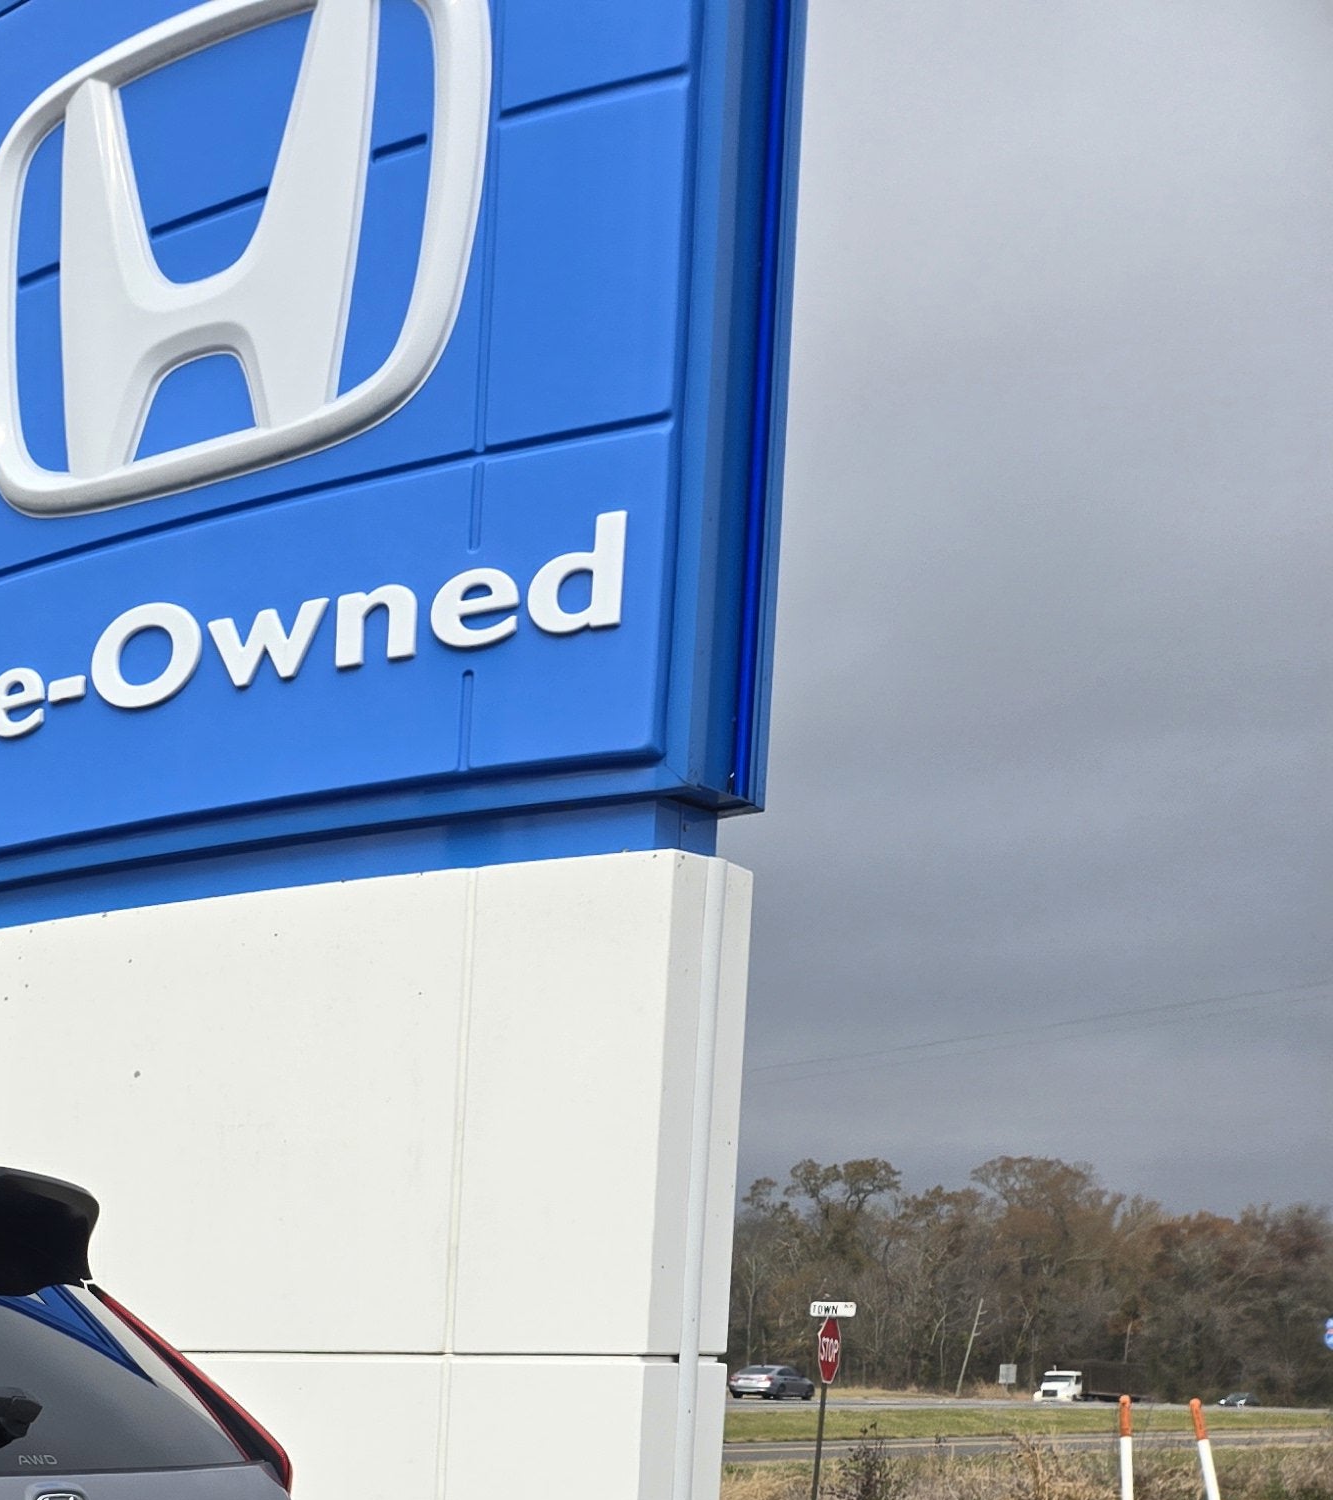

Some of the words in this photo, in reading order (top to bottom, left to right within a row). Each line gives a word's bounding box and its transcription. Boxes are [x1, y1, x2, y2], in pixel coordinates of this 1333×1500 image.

[813, 1304, 839, 1315] TOWN
[820, 1336, 839, 1363] STOP
[18, 1454, 58, 1466] AWD
